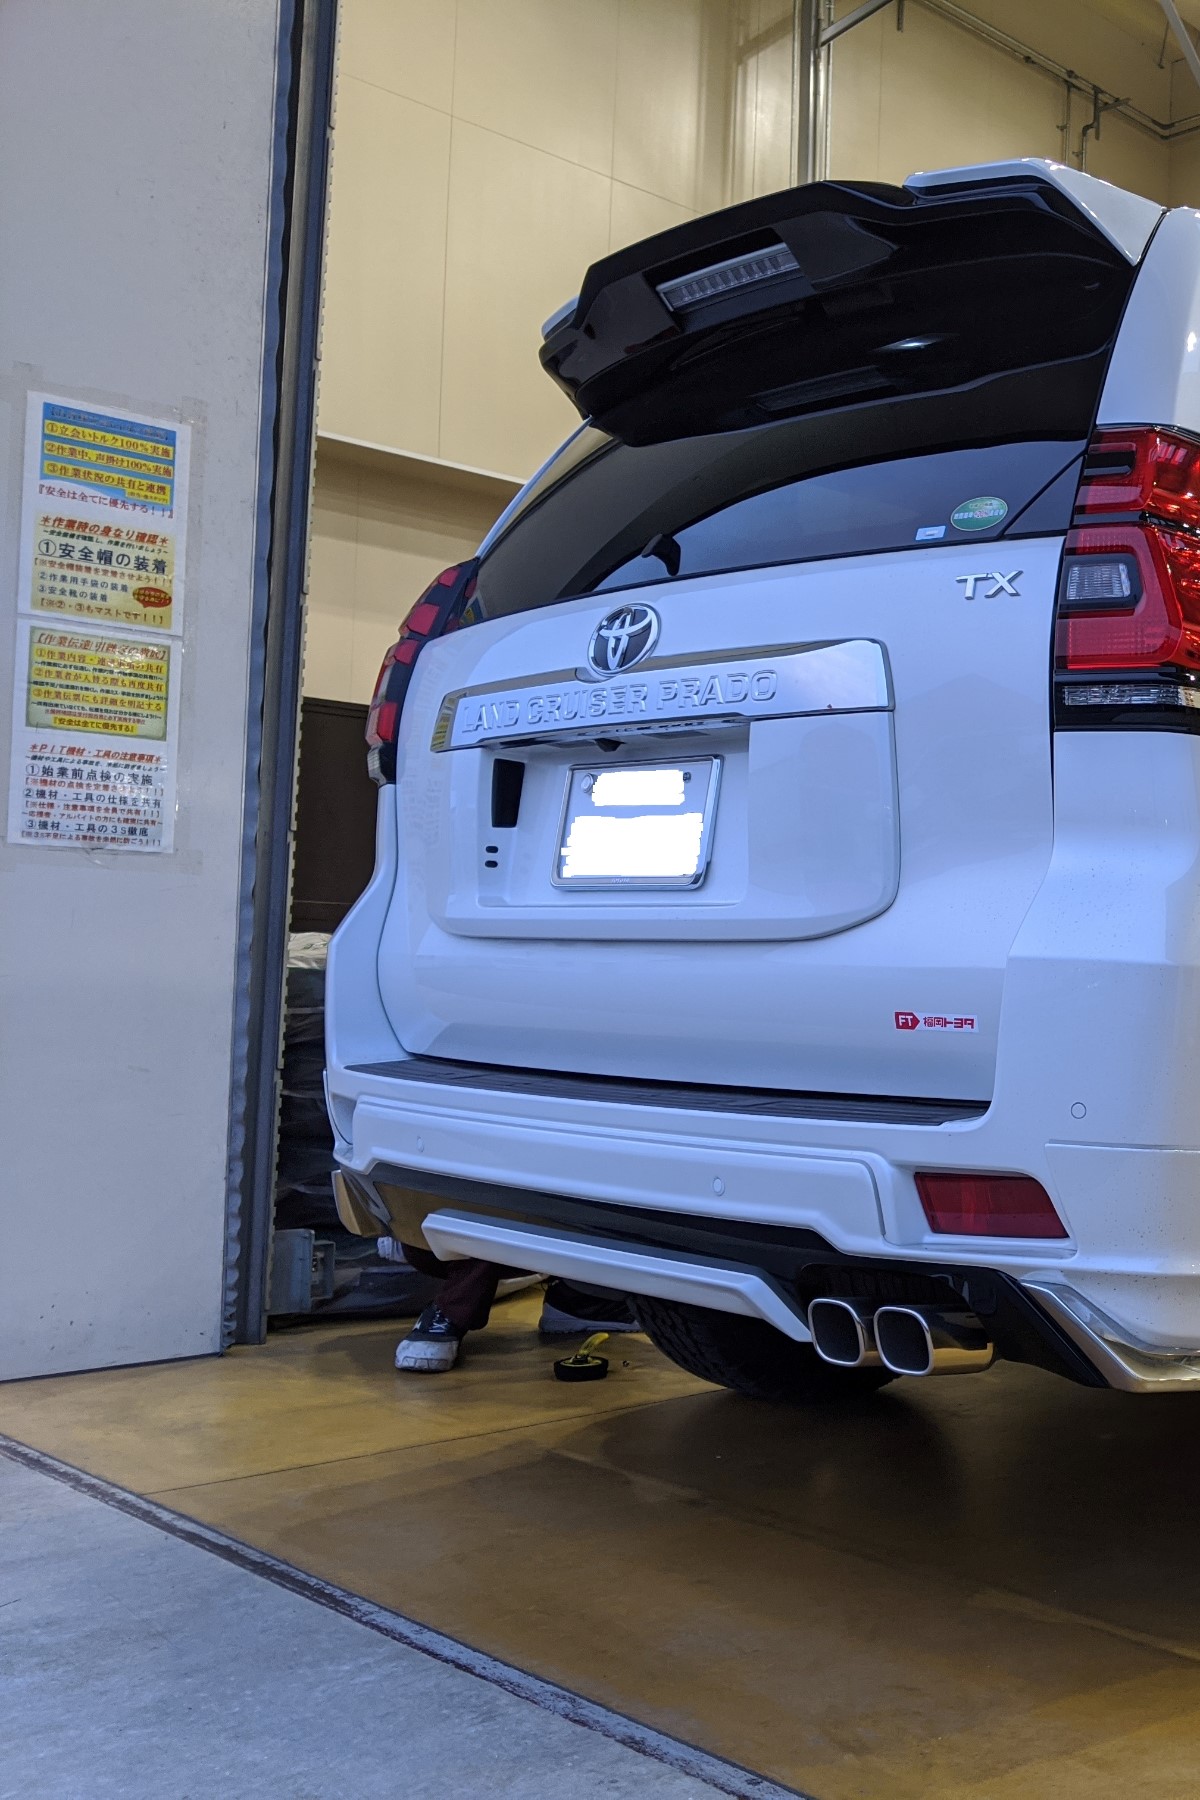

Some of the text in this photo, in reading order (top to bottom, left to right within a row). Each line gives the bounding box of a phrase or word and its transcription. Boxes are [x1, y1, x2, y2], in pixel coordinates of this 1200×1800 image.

[38, 538, 167, 574] ①安全帽の装着
[37, 583, 107, 602] ③安全靴の装着
[955, 570, 1024, 600] TX
[461, 669, 778, 733] LAND CRUISER PRADO
[25, 763, 153, 785] ①始業前点検の実施
[898, 1014, 975, 1029] FT 福岡トヨタ
